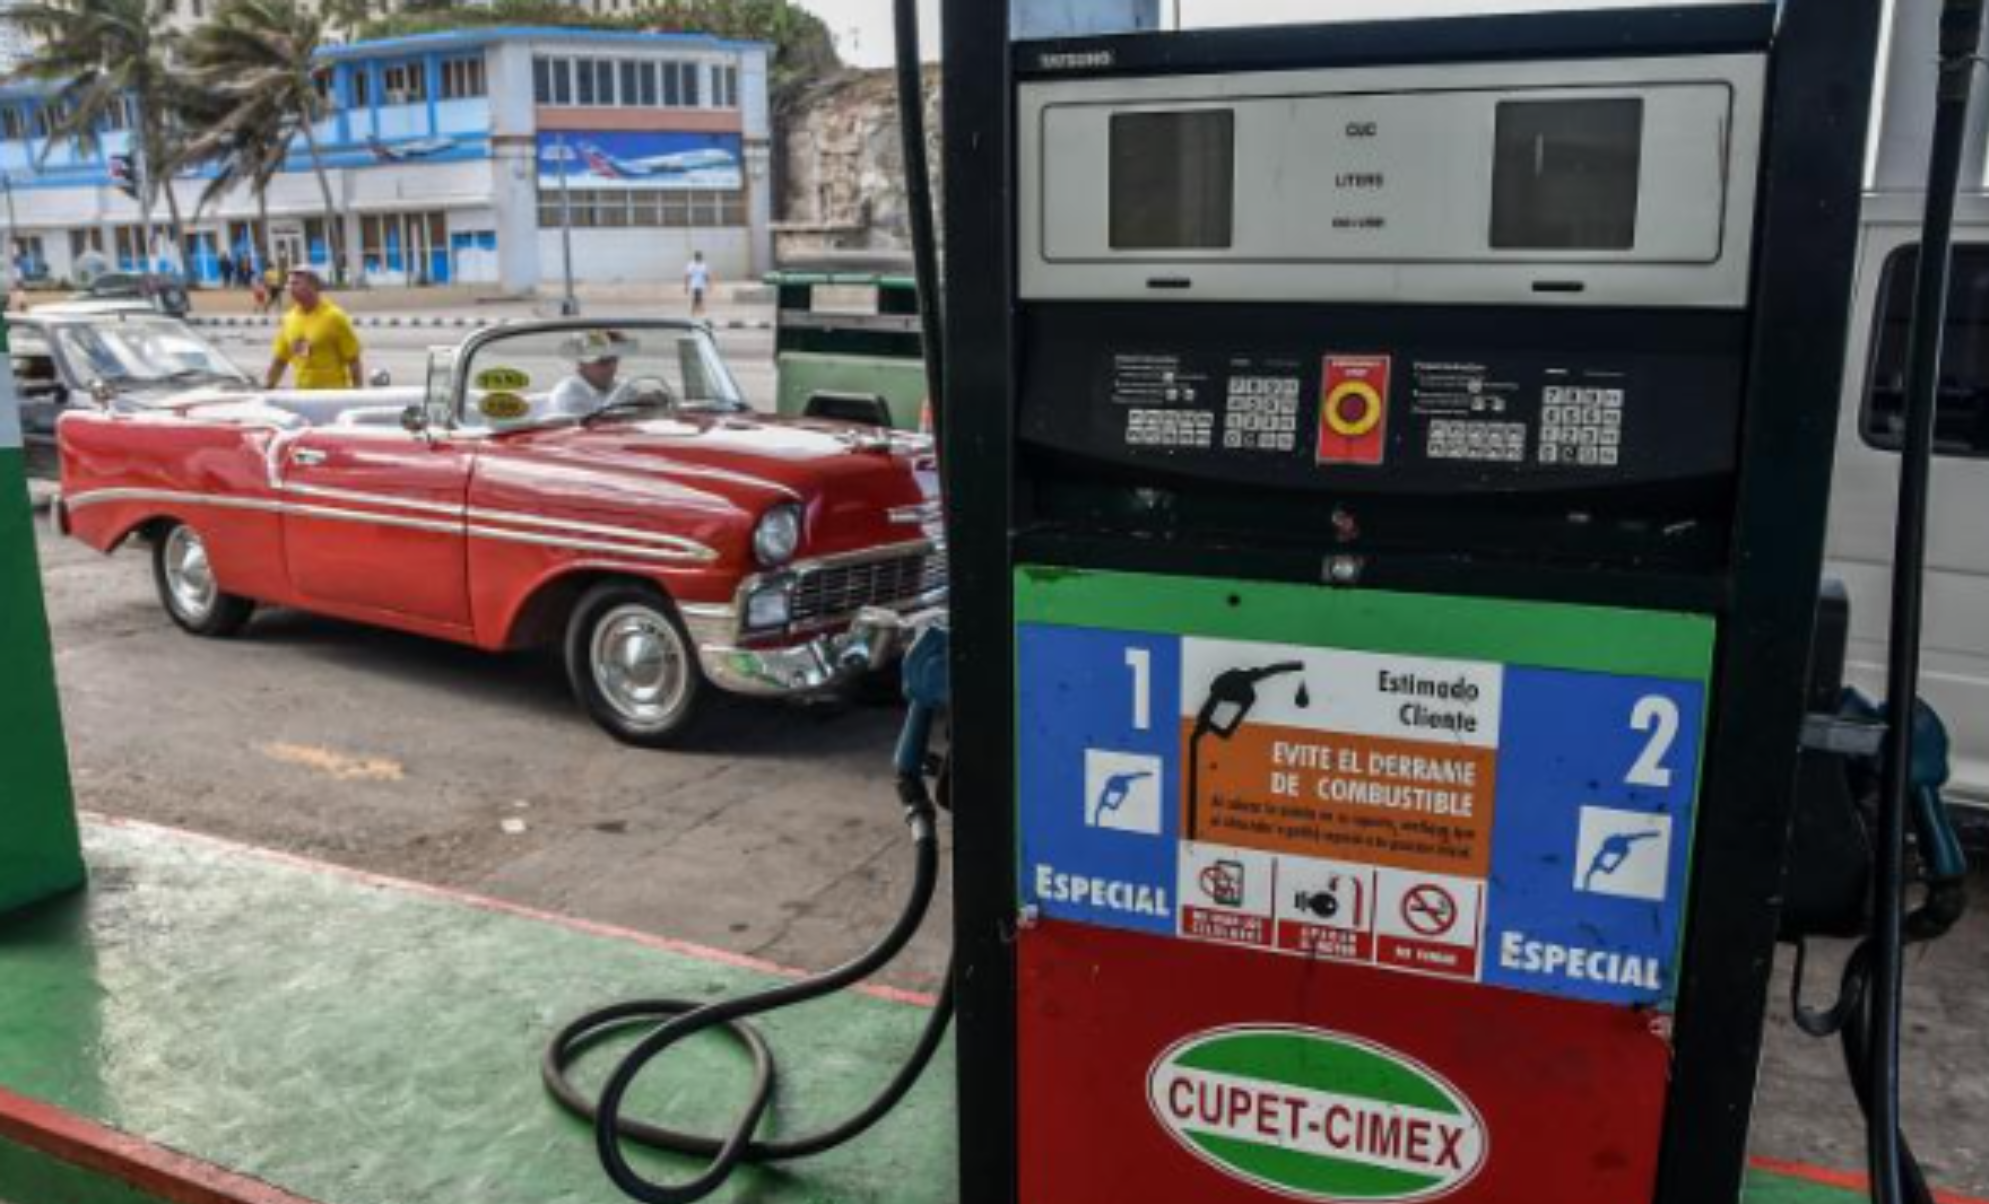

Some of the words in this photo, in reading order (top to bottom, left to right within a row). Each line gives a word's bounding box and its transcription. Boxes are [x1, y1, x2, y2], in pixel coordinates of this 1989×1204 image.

[1345, 121, 1377, 137] CUC
[1125, 647, 1150, 730] 1
[1379, 670, 1479, 700] Estimado
[1400, 703, 1477, 732] Cliente
[1624, 694, 1679, 787] 2
[1272, 742, 1331, 770] EVITE
[1338, 748, 1363, 774] EL
[1369, 753, 1476, 786] DERRAME
[1271, 772, 1299, 797] DE
[1318, 778, 1473, 817] COMBUSTIBLE
[1036, 864, 1170, 917] ESPECIAL
[1500, 930, 1660, 990] ESPECIAL
[1168, 1076, 1465, 1170] CUPET-CIMEX
